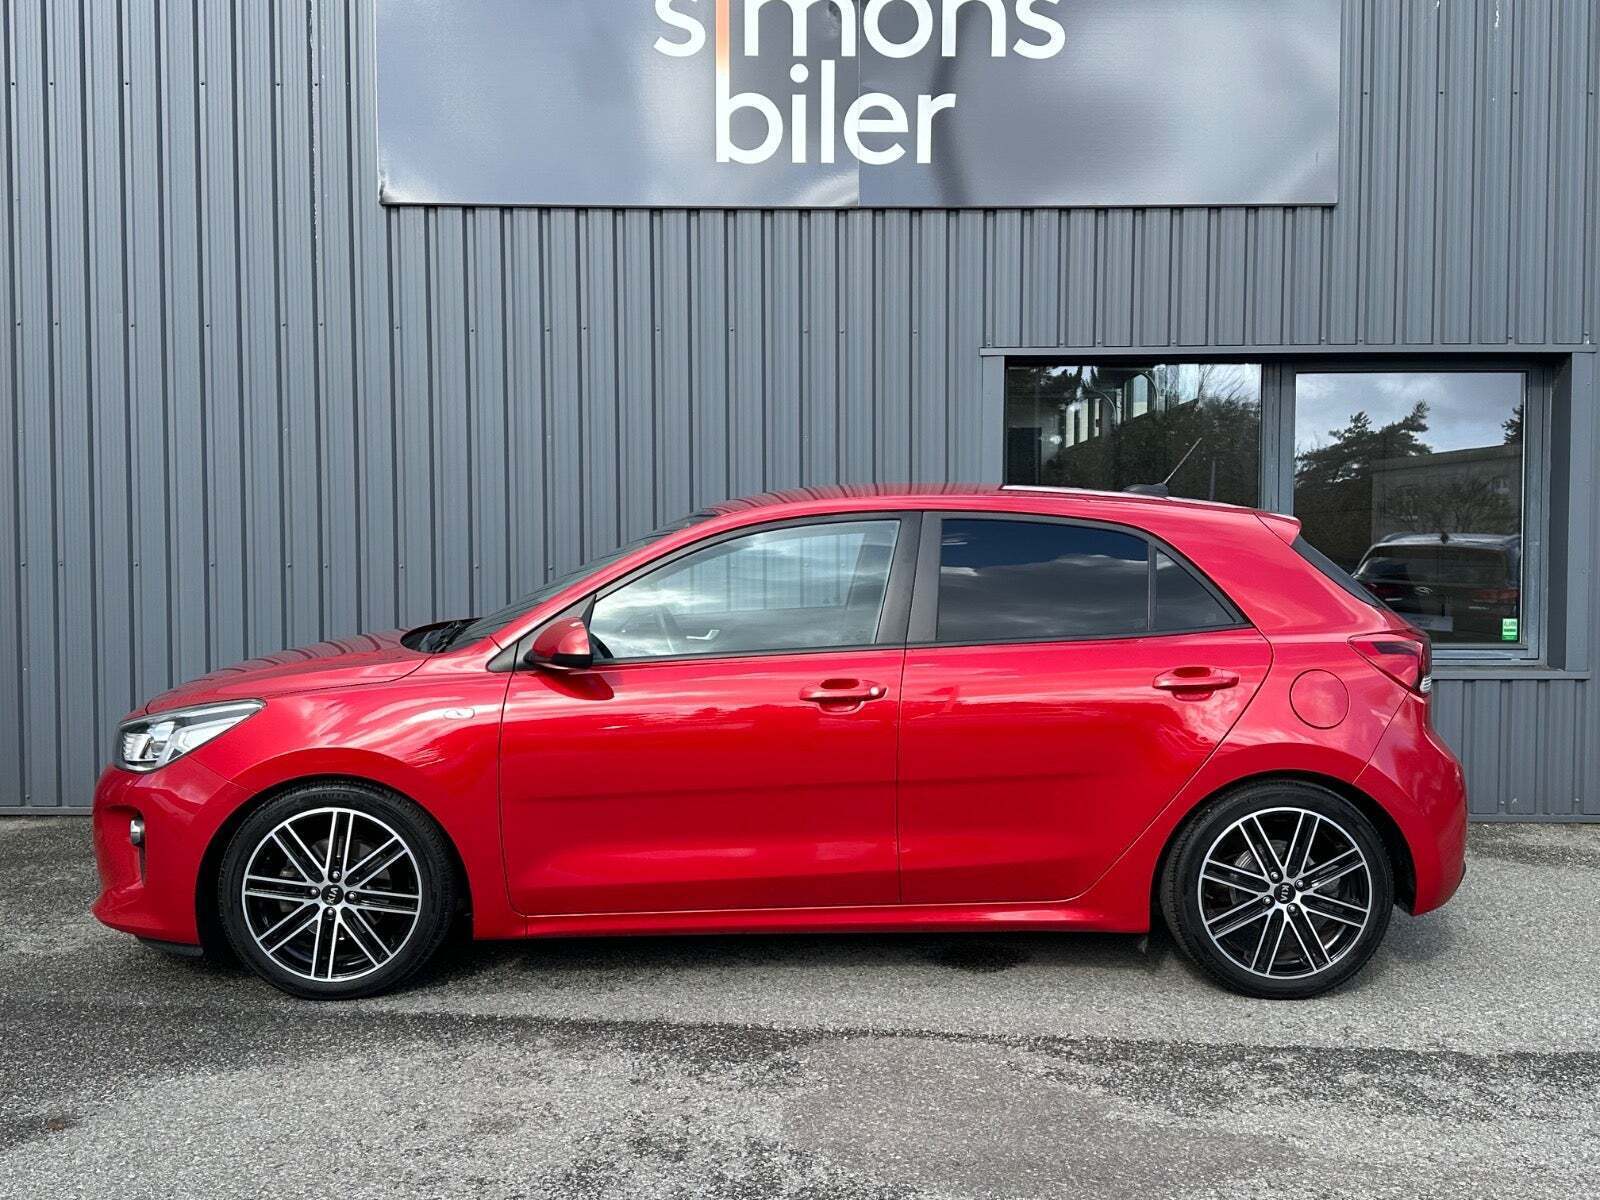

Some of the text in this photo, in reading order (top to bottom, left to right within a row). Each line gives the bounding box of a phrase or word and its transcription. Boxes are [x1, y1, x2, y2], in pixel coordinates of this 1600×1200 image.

[715, 60, 957, 165] biler
[327, 887, 338, 904] KIA
[1280, 885, 1289, 901] KIA
